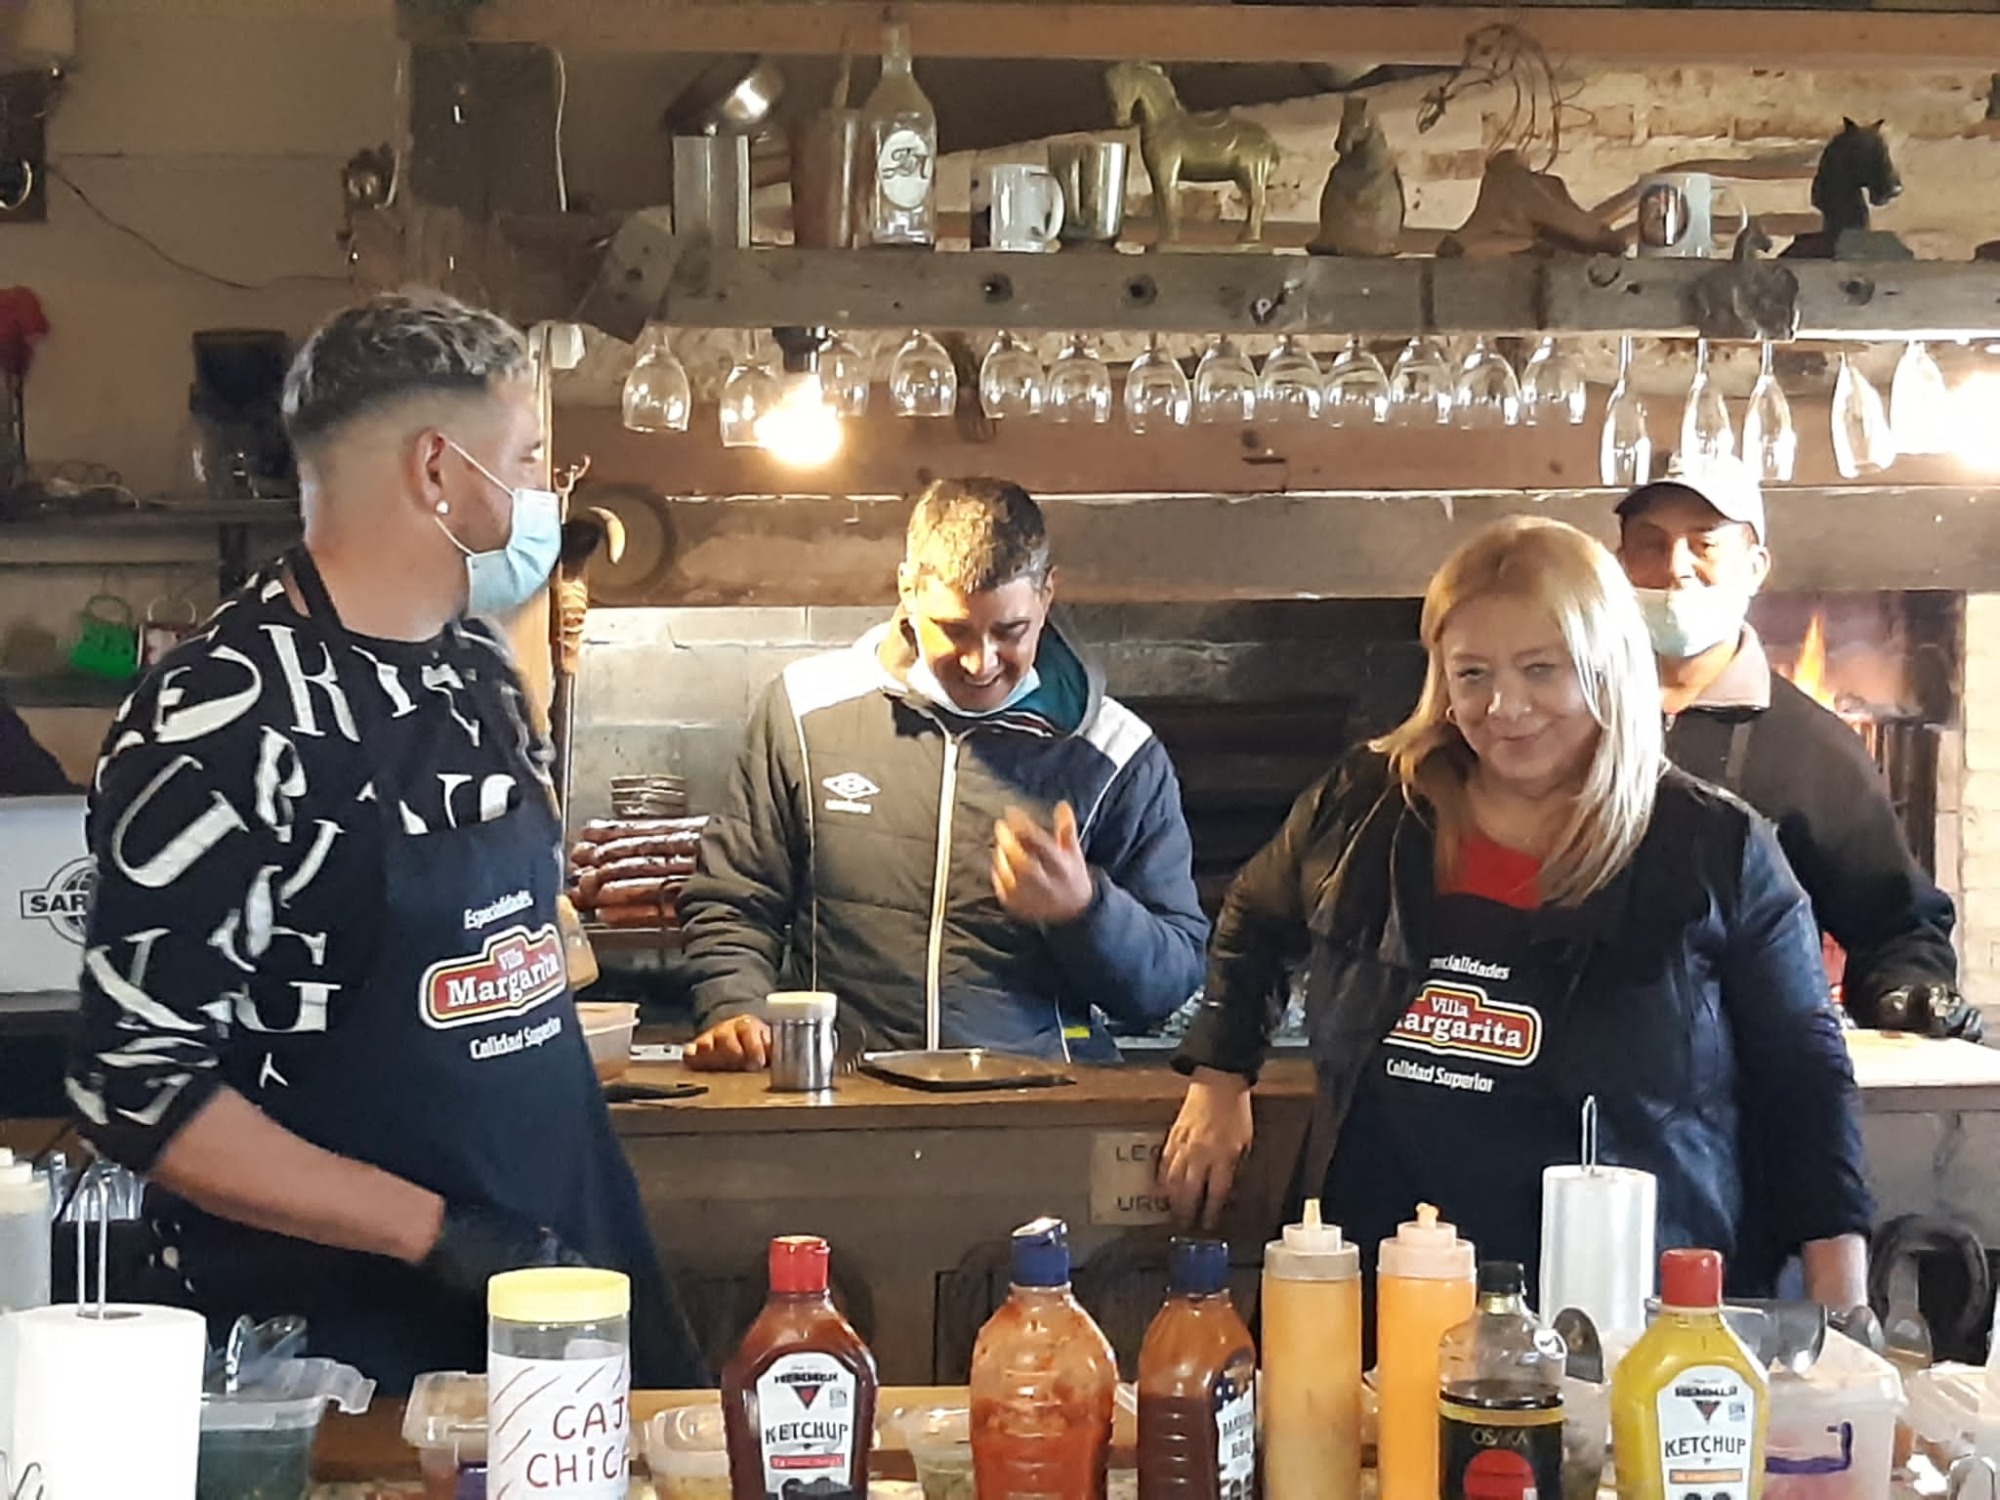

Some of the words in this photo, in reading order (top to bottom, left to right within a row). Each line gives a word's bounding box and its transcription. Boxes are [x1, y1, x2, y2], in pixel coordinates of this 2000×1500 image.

[1431, 996, 1470, 1018] Villa
[1394, 1012, 1523, 1048] argarita
[1386, 1058, 1436, 1082] Calidad
[1434, 1067, 1495, 1093] Superior
[765, 1422, 848, 1445] KETCHUP
[1664, 1435, 1746, 1458] KETCHUP
